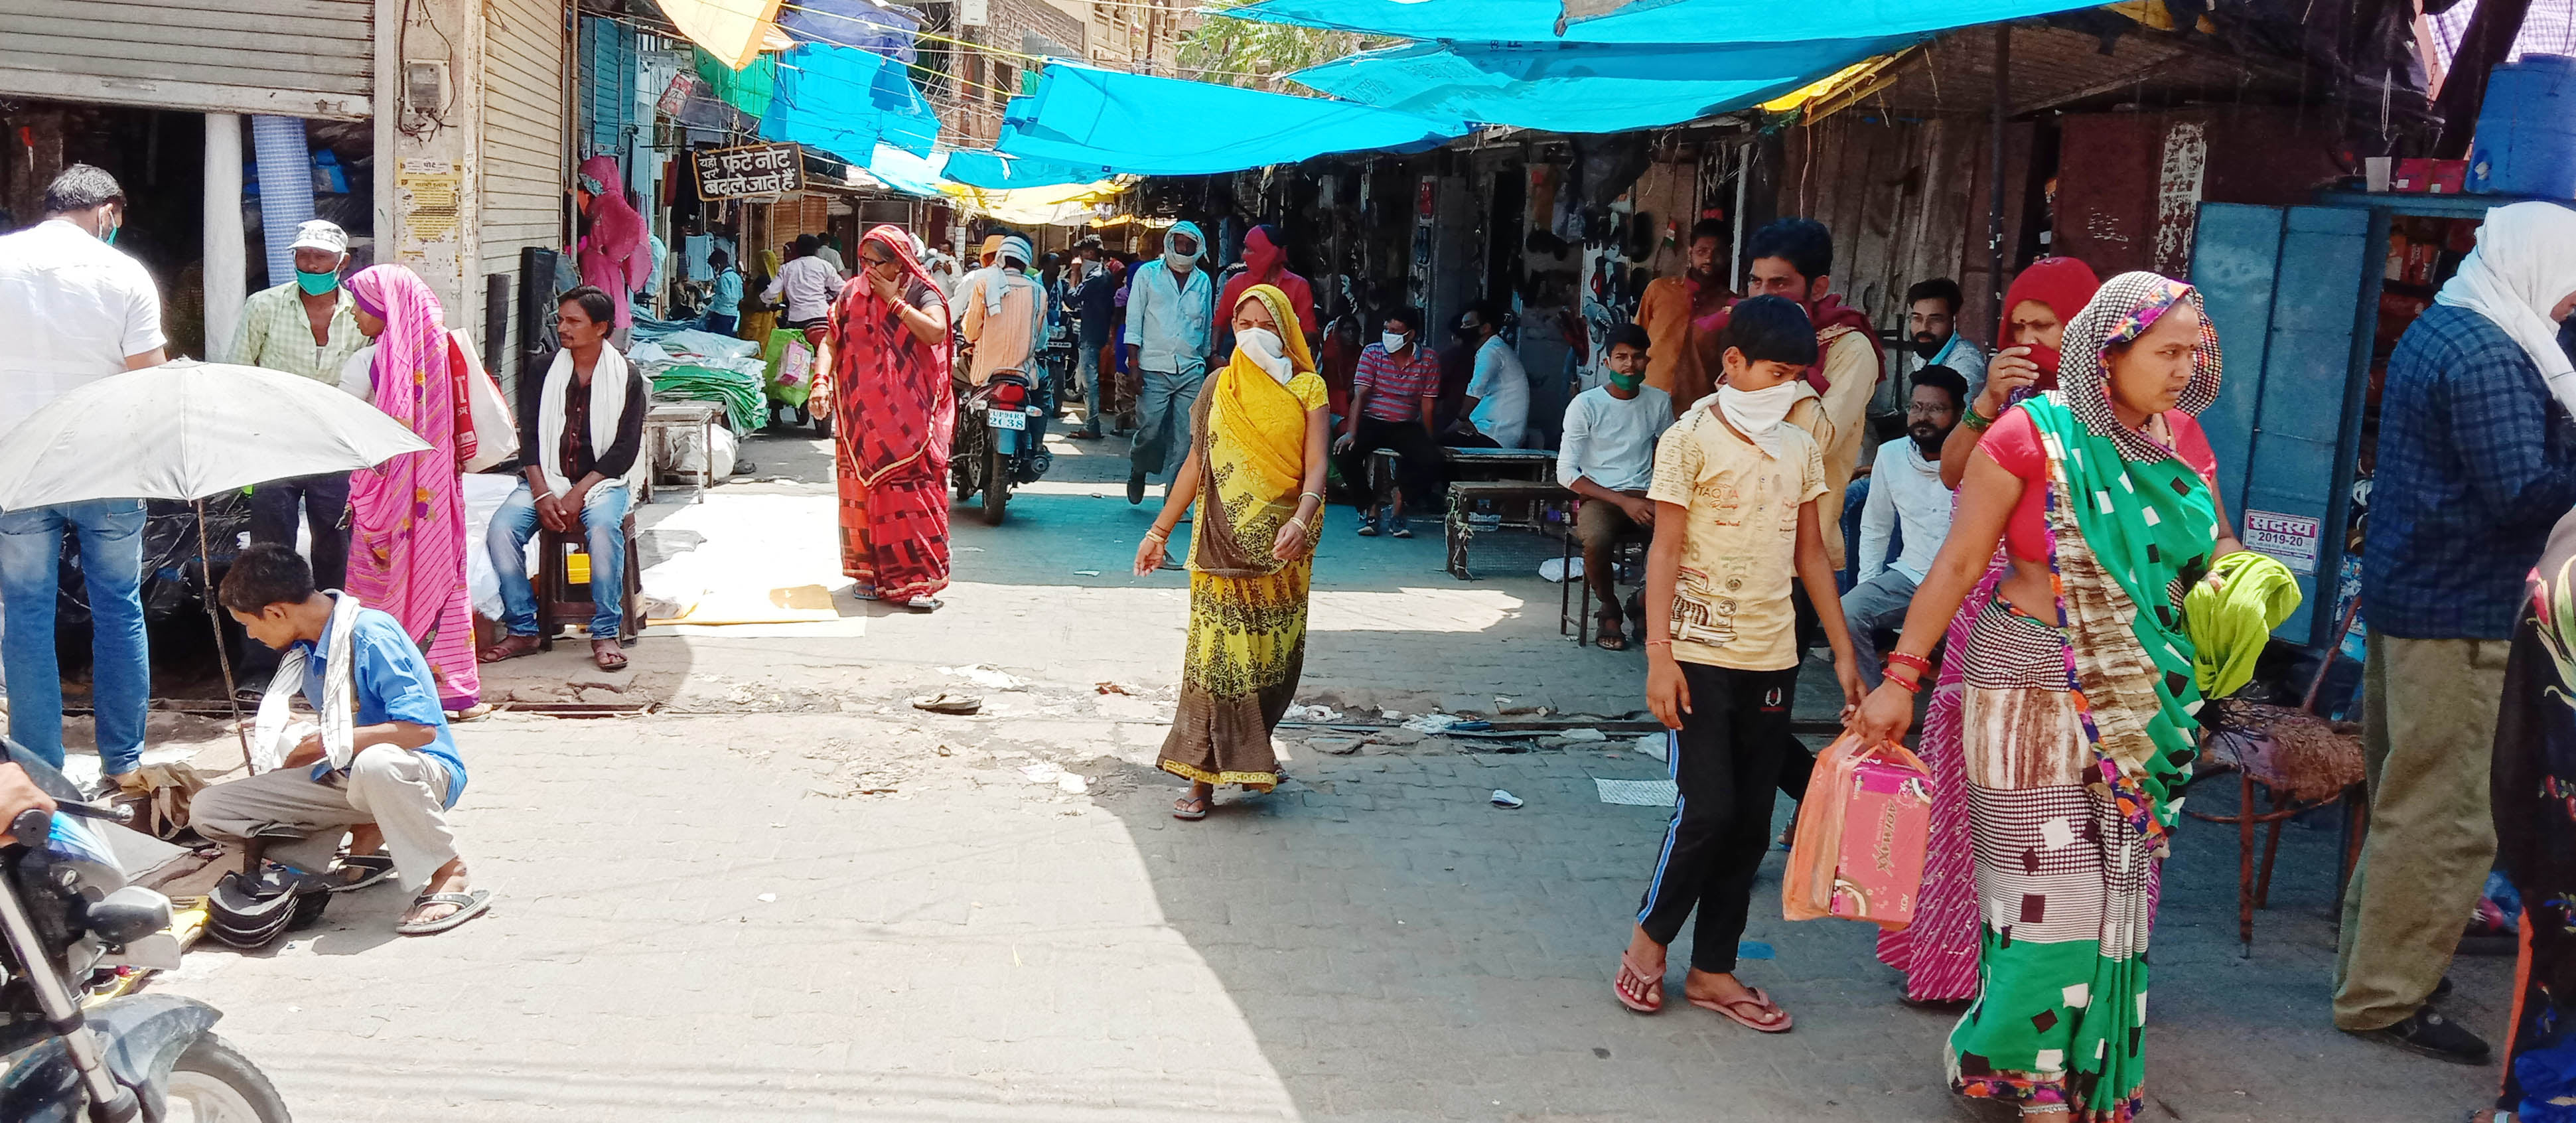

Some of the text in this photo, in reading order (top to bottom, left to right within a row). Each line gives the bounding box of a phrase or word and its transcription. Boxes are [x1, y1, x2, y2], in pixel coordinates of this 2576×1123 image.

[754, 146, 791, 170] नोट
[2250, 516, 2313, 536] सदस्य
[2257, 532, 2303, 547] 2019-20
